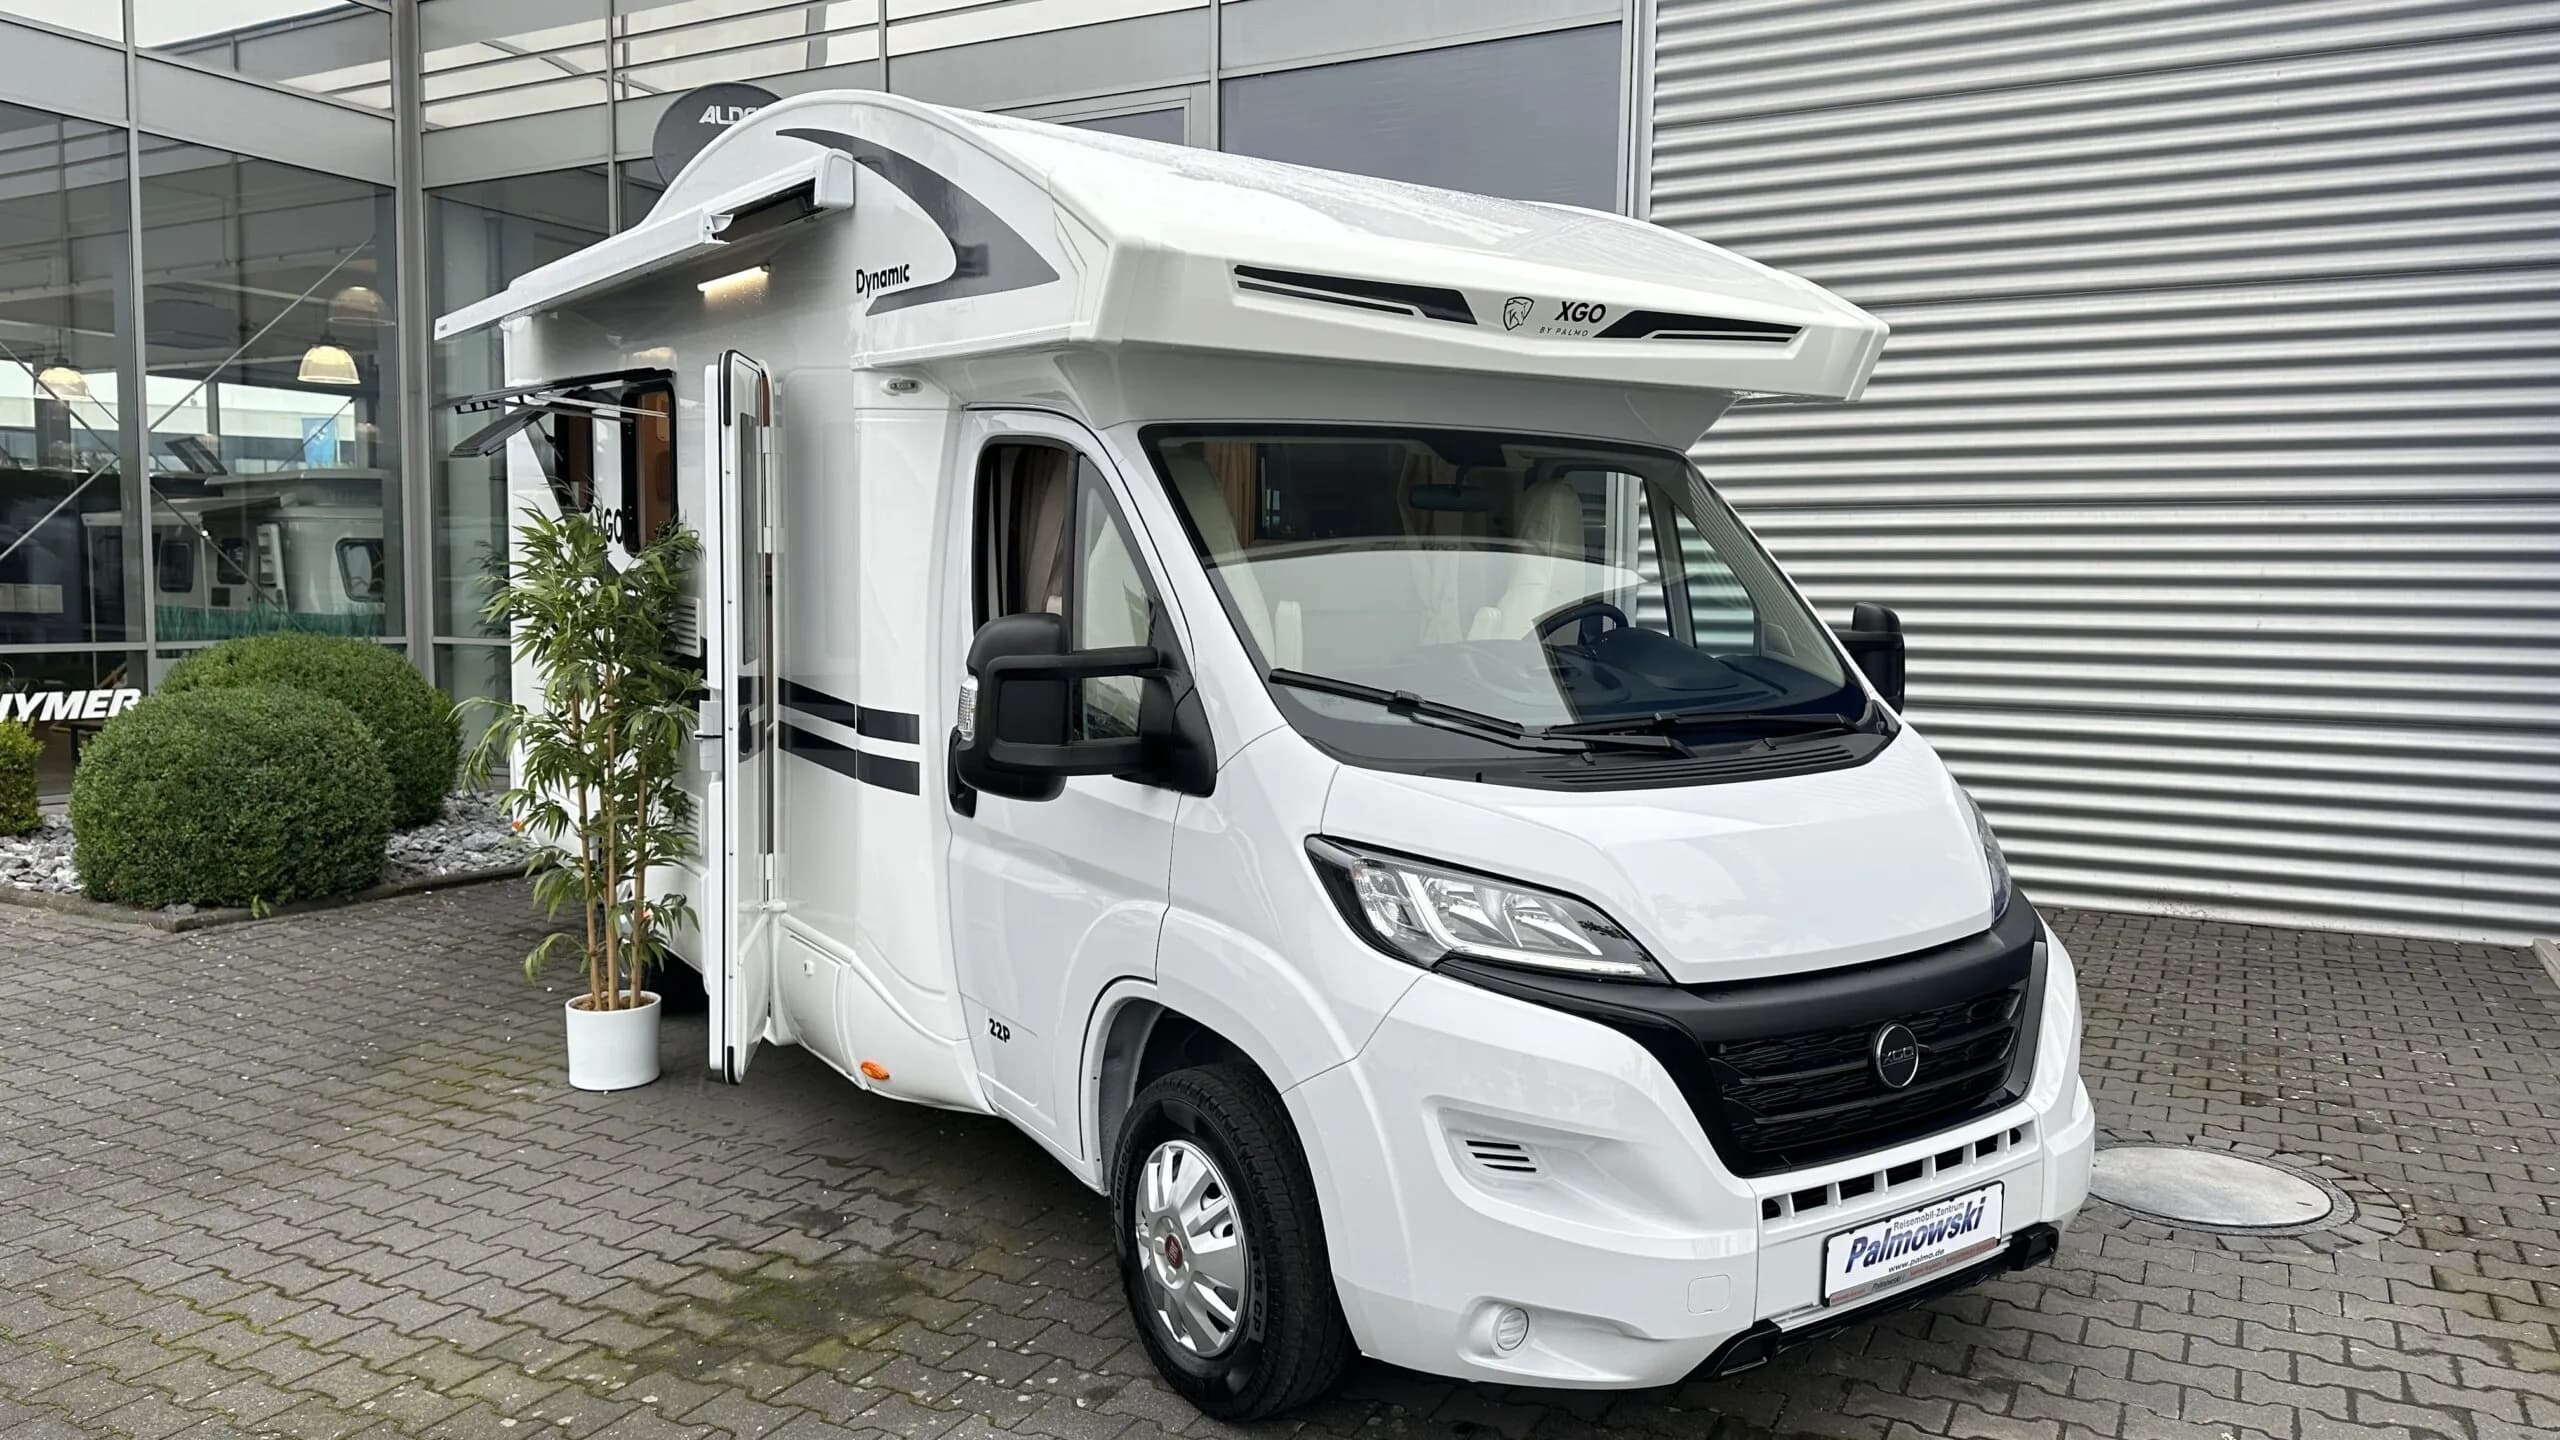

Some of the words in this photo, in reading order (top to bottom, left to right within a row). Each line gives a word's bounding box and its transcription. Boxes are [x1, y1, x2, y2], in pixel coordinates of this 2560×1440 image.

[856, 264, 910, 299] Dynamic
[1554, 301, 1606, 324] XGO
[1539, 326, 1553, 335] BY
[1555, 327, 1589, 337] PALMO
[597, 508, 623, 545] GO
[989, 1018, 1010, 1043] 22P
[1893, 1201, 1965, 1232] Reisemobil-Zentrum
[1845, 1196, 1988, 1274] Palmowski
[1888, 1248, 1945, 1273] www.palmo.de
